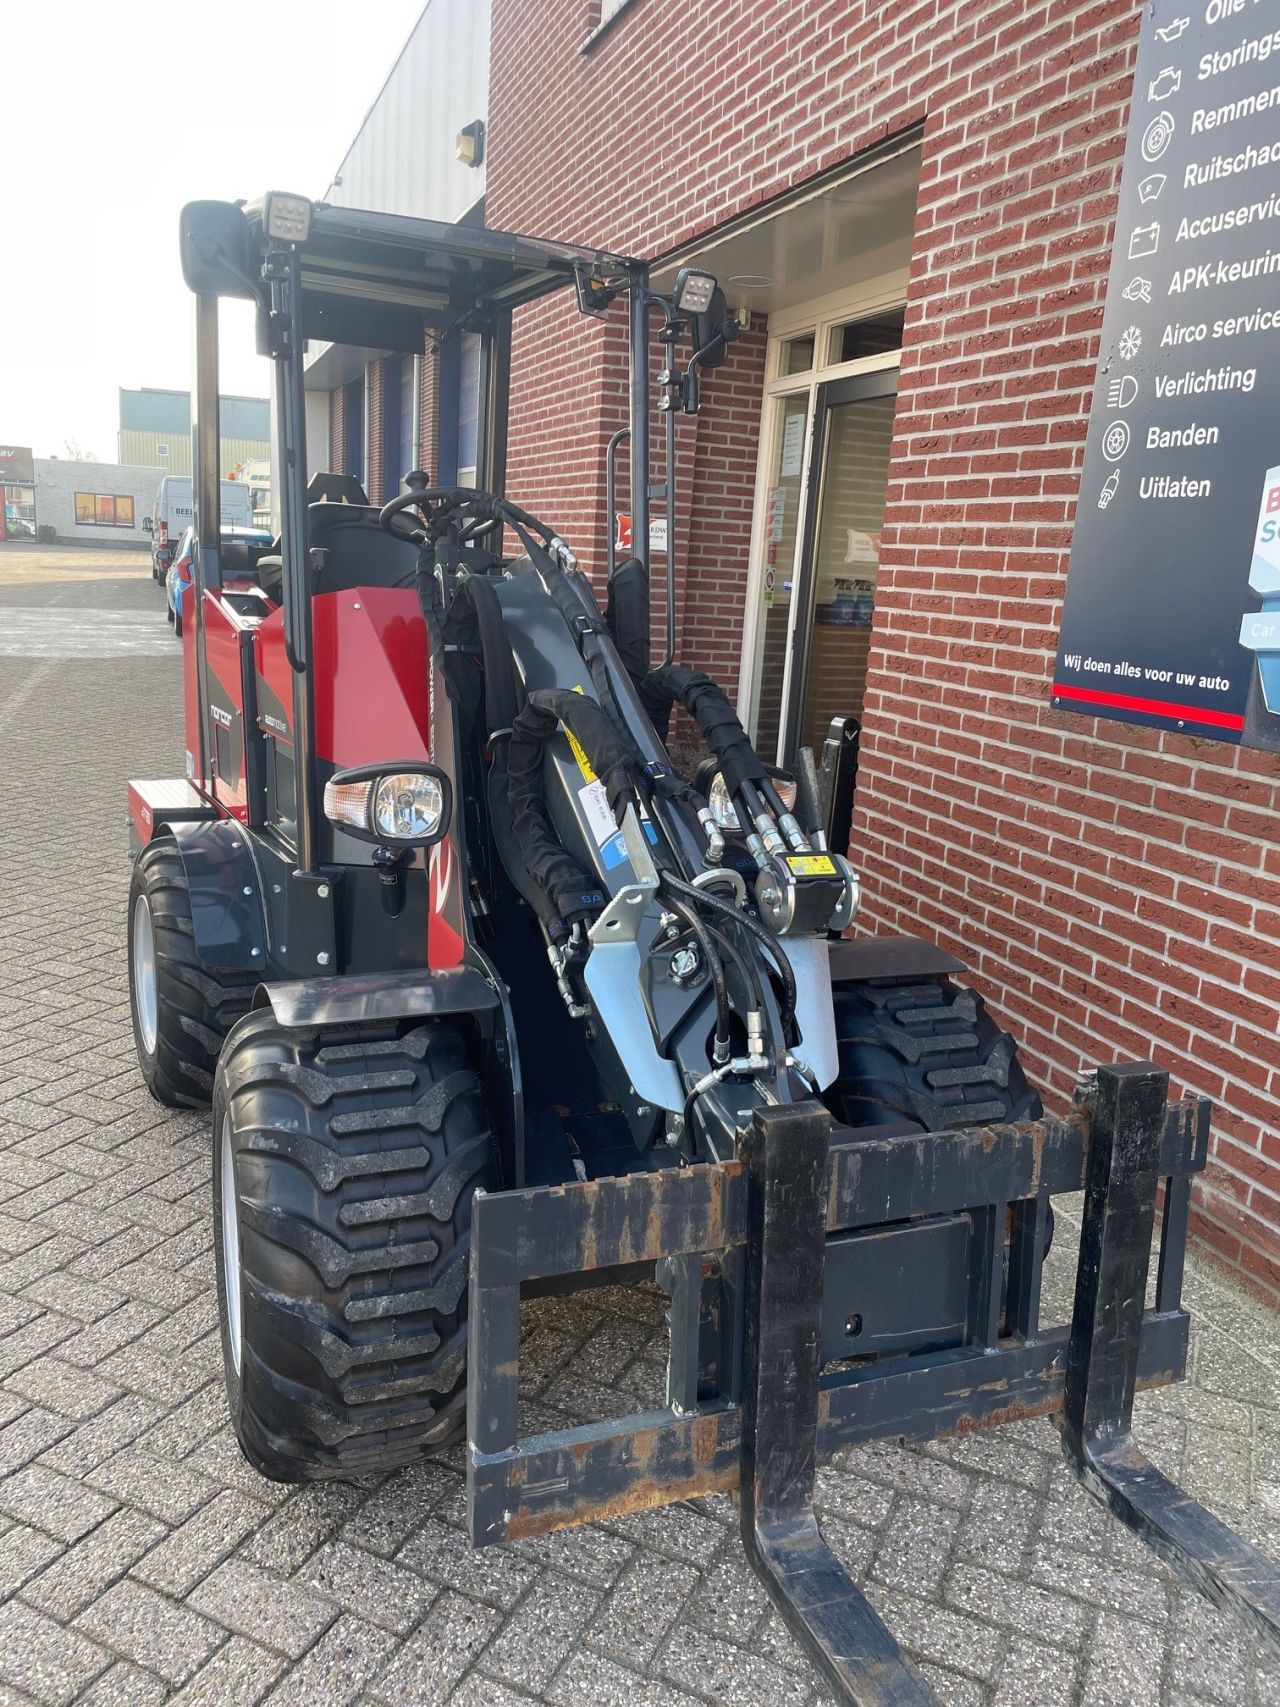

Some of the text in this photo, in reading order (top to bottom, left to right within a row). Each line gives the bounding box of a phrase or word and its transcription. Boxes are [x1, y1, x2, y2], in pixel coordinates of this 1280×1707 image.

[1160, 307, 1280, 347] Airco service
[1155, 366, 1256, 398] Verlichting
[1146, 423, 1219, 449] Banden
[1139, 476, 1211, 499] Uitlaten
[1251, 623, 1276, 638] Car
[1064, 654, 1230, 691] Wij doen alles voor uw auto
